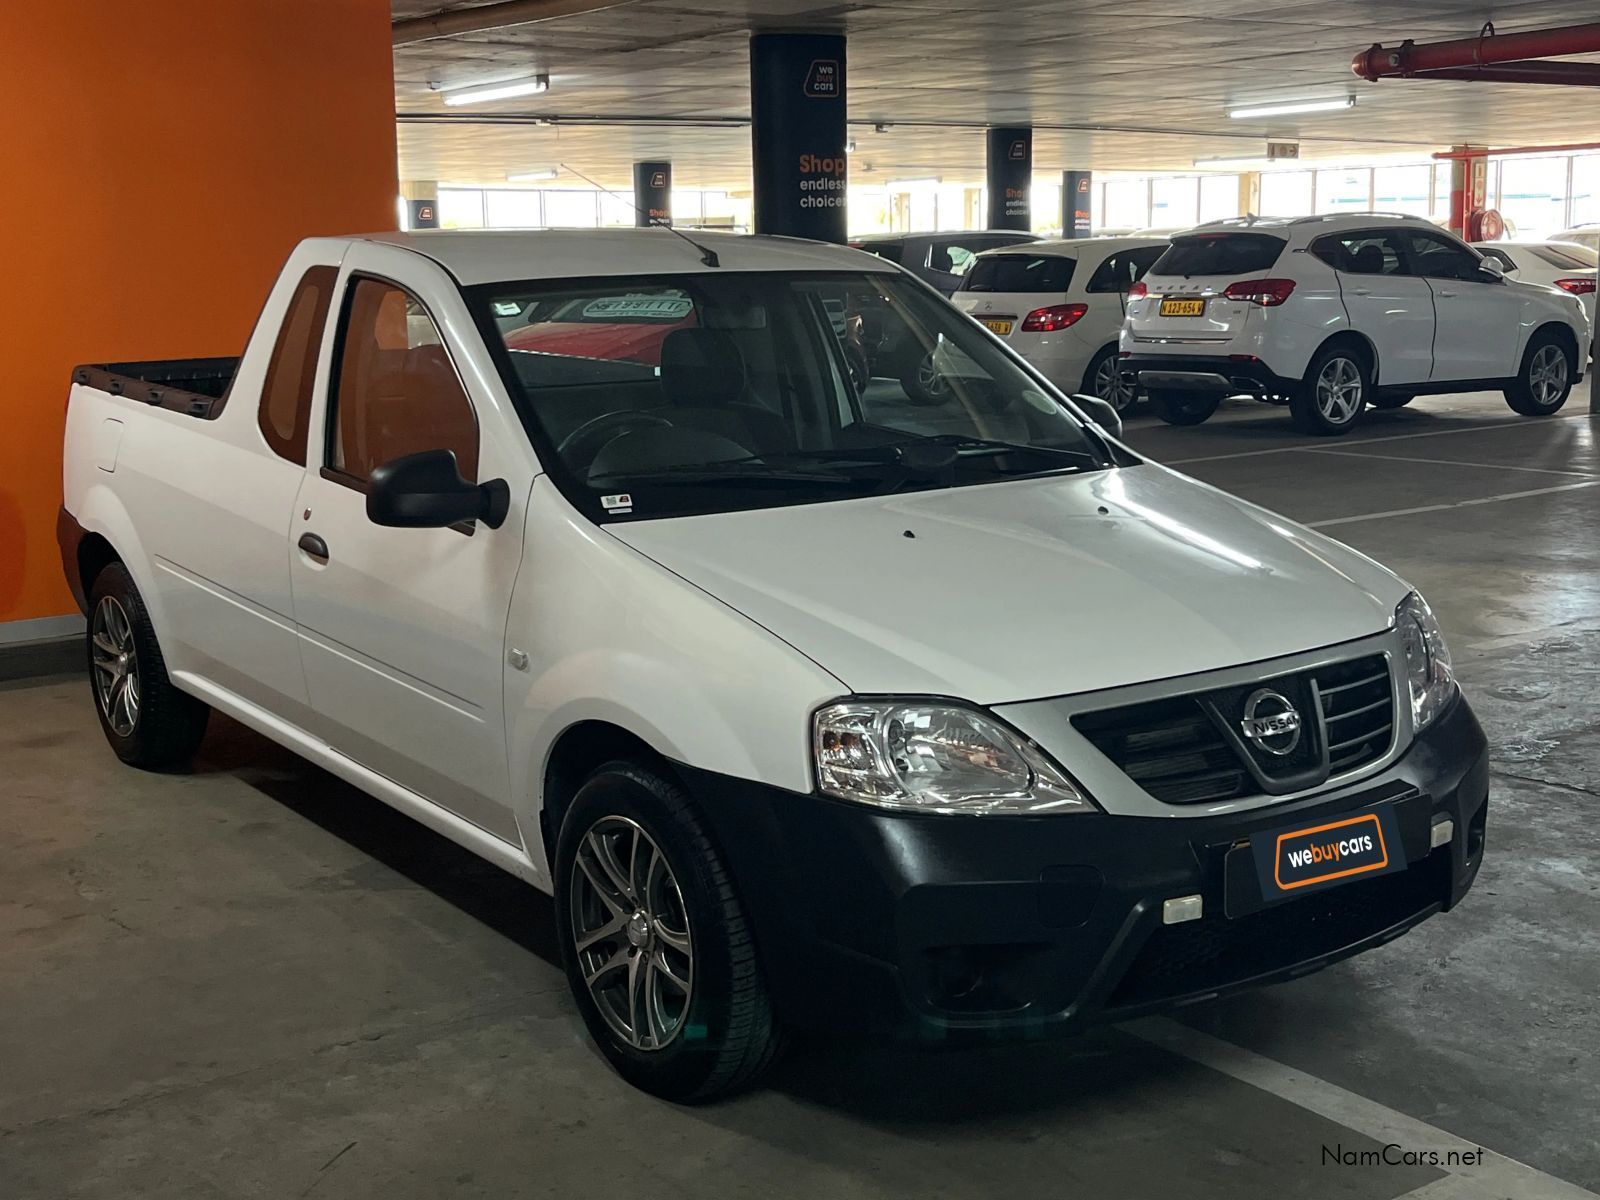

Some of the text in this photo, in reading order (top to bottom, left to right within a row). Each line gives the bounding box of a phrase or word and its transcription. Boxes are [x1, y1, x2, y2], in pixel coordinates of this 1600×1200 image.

[818, 66, 834, 74] we
[813, 83, 834, 91] cars
[799, 154, 845, 177] Shop
[1253, 715, 1300, 734] NISSAN
